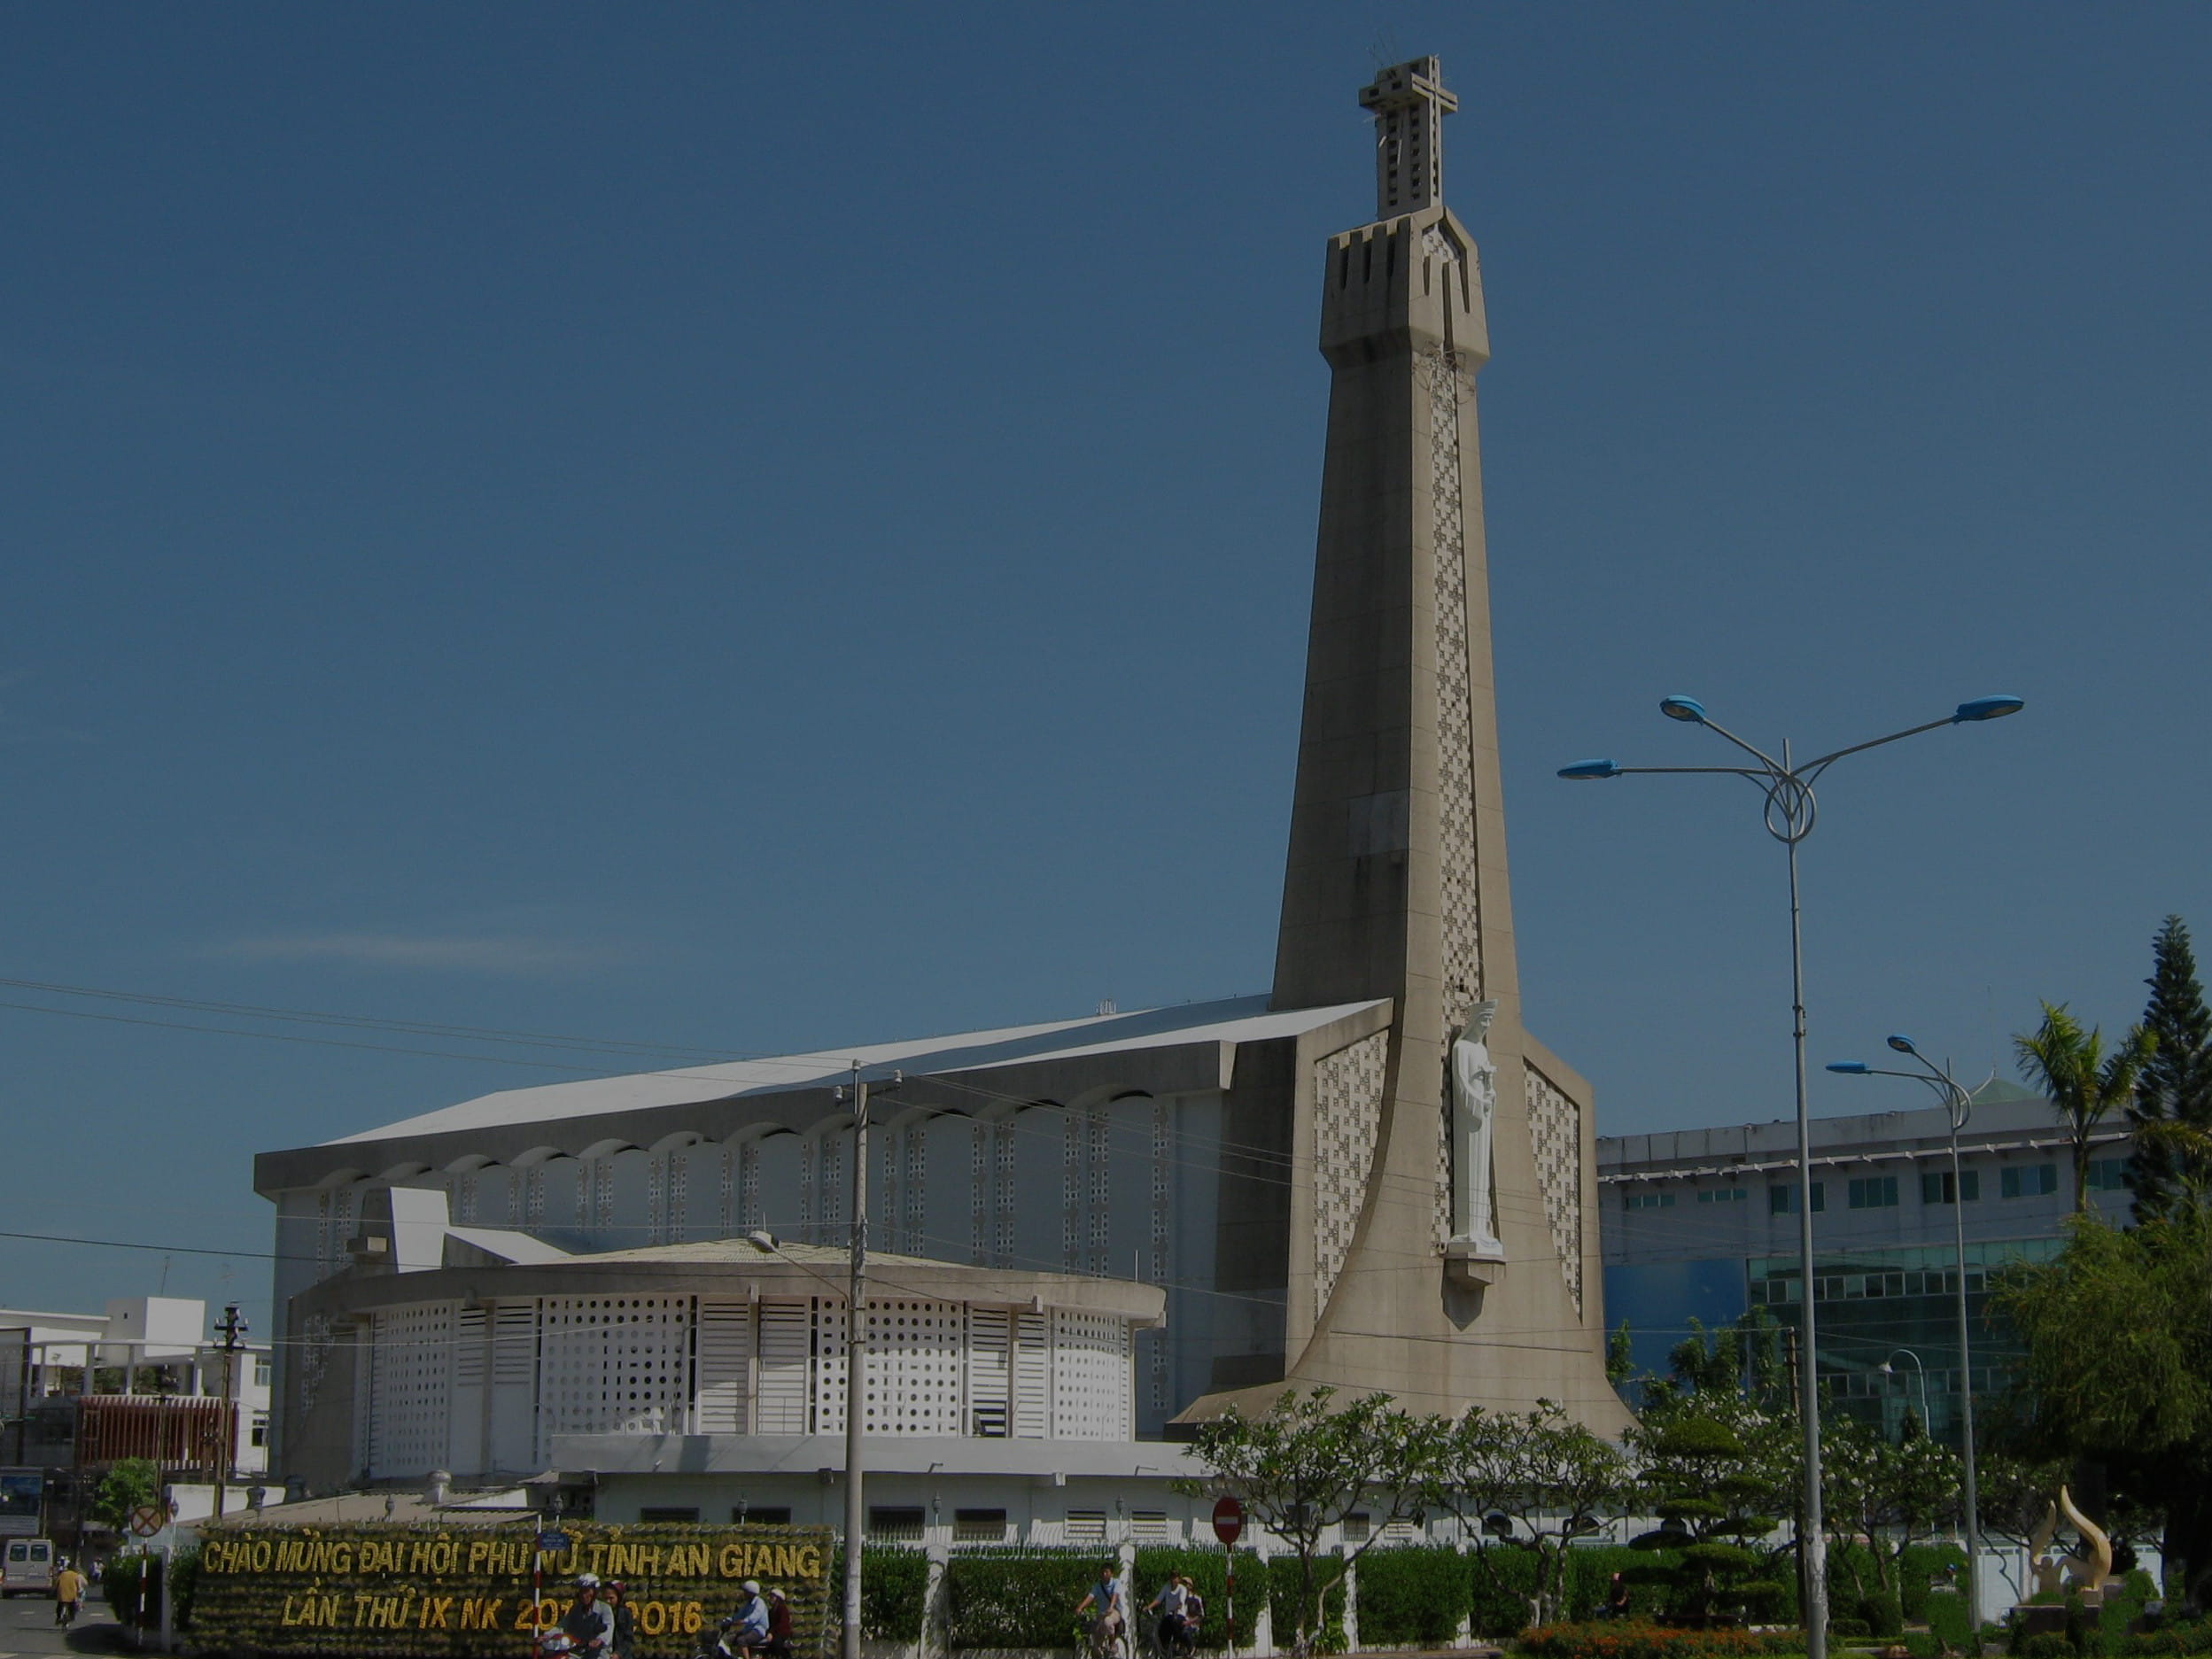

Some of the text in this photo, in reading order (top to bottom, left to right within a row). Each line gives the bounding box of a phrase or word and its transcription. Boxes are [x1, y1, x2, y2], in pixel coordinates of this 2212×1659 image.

[275, 1528, 352, 1574] MỪNG
[409, 1532, 460, 1585] HỘI
[467, 1541, 529, 1585] PHỤ
[664, 1543, 709, 1577] AN
[718, 1543, 820, 1578] GIANG
[281, 1577, 340, 1626] LẦN
[418, 1597, 453, 1629] IX
[461, 1598, 503, 1630] NK
